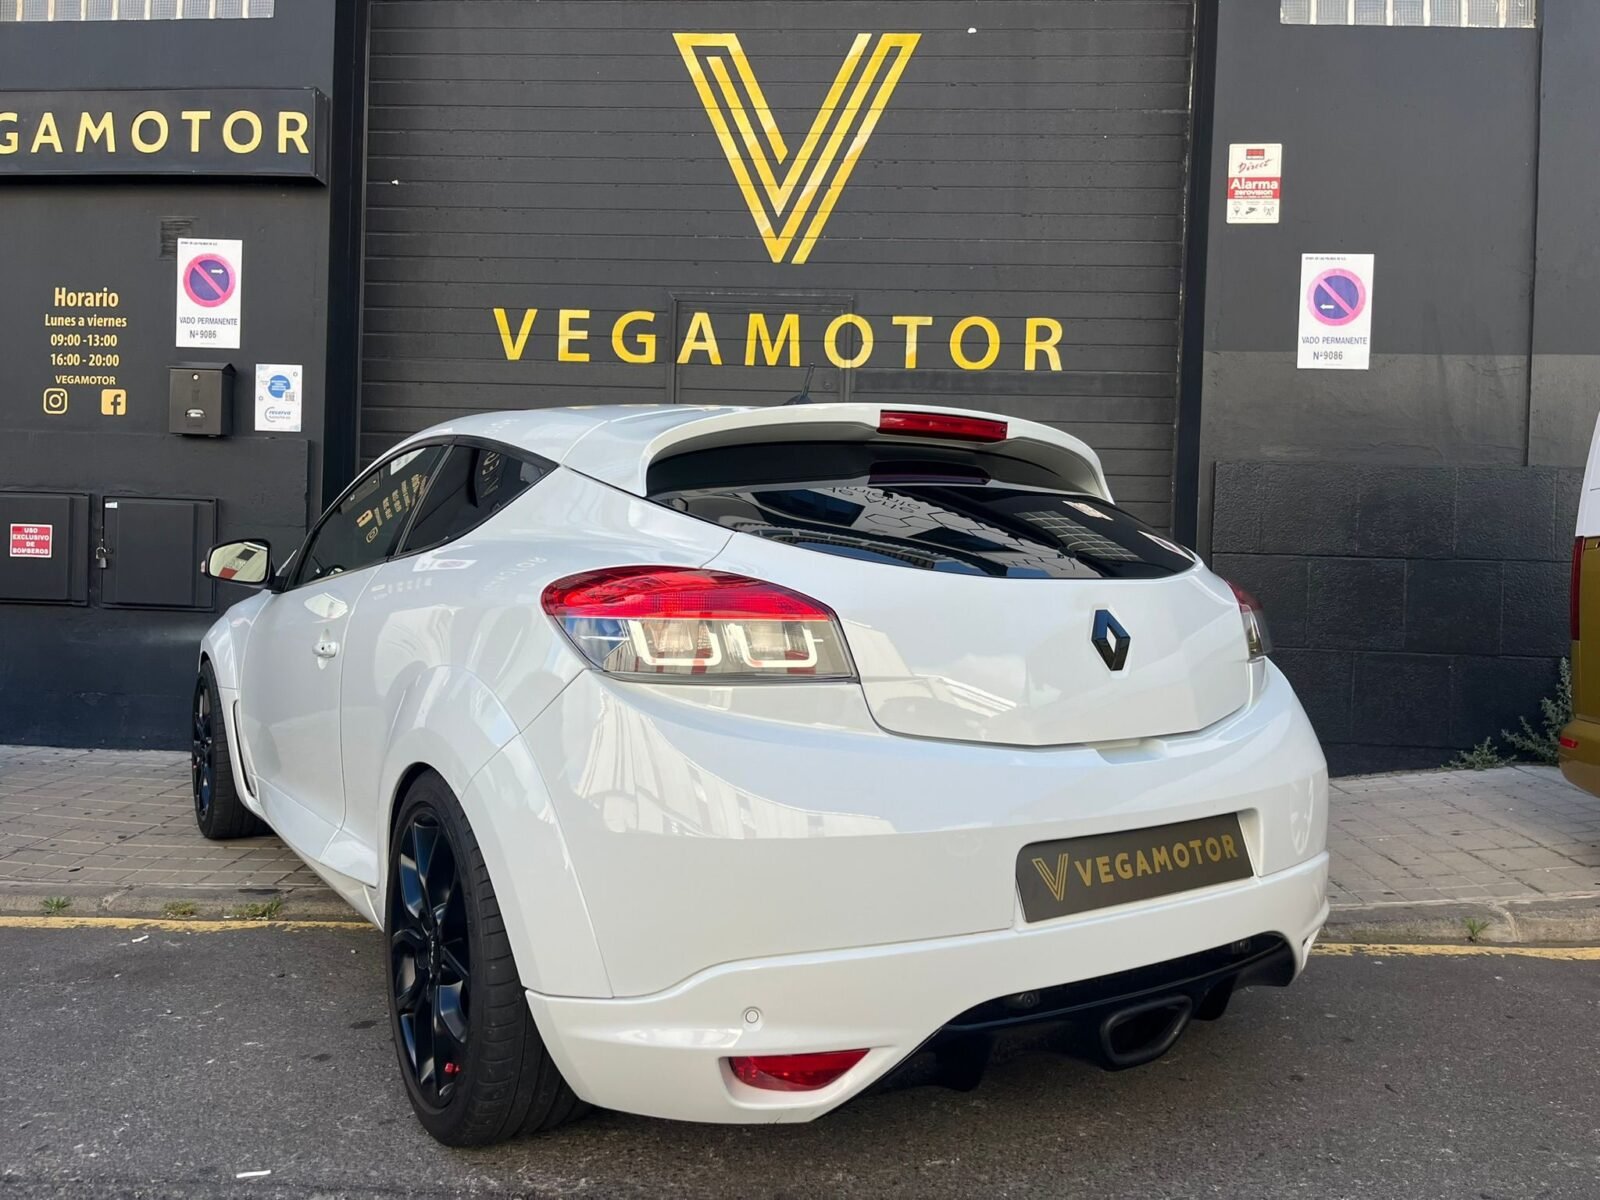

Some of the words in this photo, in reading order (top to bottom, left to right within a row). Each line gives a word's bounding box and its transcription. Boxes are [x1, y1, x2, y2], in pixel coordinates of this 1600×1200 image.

[1230, 178, 1279, 190] Alarma
[54, 287, 119, 307] Horario
[45, 313, 76, 327] Lunes
[78, 316, 85, 327] a
[87, 314, 127, 328] viernes
[179, 317, 196, 325] VADO
[197, 317, 238, 326] PERMANENTE
[50, 334, 81, 346] 09:00
[493, 307, 1064, 371] VEGAMOTOR
[1302, 336, 1320, 345] VADO
[1322, 336, 1368, 345] PERMANENTE
[50, 353, 81, 366] 16:00
[88, 354, 120, 367] 20:00
[55, 375, 116, 385] VEGAMOTOR
[1074, 834, 1239, 887] VEGAMOTOR
